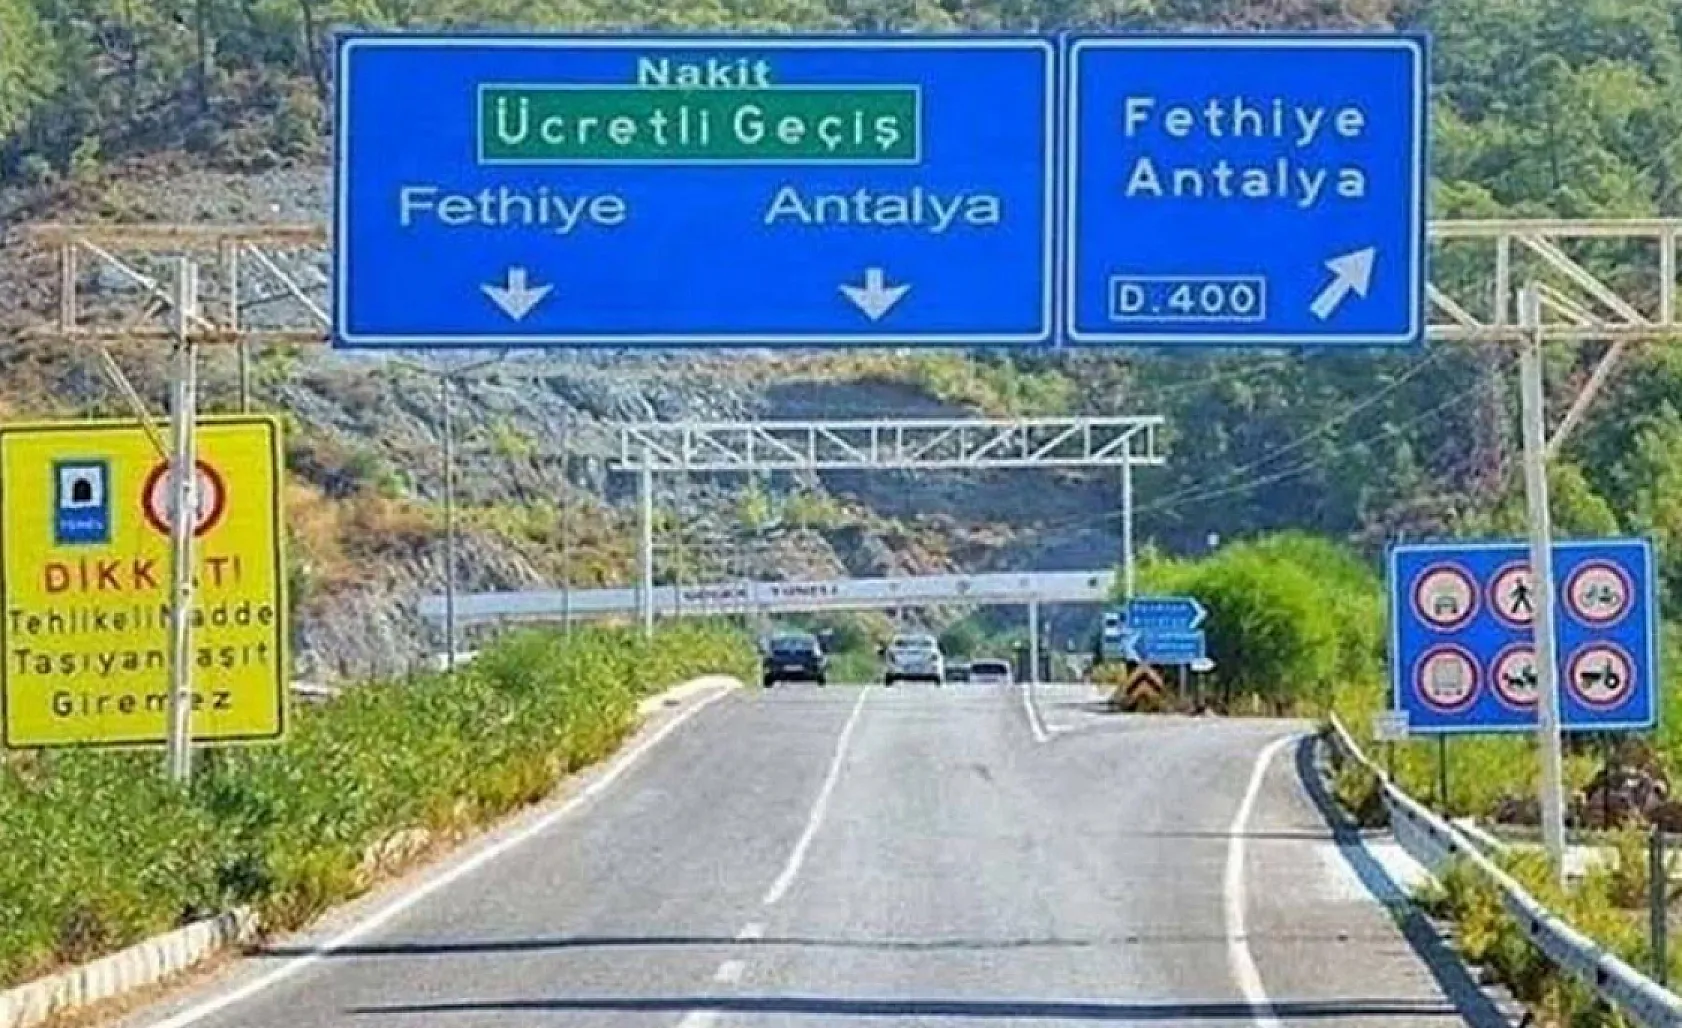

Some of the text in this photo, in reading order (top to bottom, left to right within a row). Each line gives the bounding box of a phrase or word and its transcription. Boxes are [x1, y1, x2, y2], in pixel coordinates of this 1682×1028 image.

[638, 57, 771, 88] Nakit
[497, 96, 900, 151] Ücretli Geçiş
[1125, 97, 1365, 147] Fethiye
[1125, 156, 1366, 208] Antalya
[400, 187, 626, 233] Fethiye
[766, 187, 1000, 233] Antalya
[1120, 285, 1255, 313] D.400
